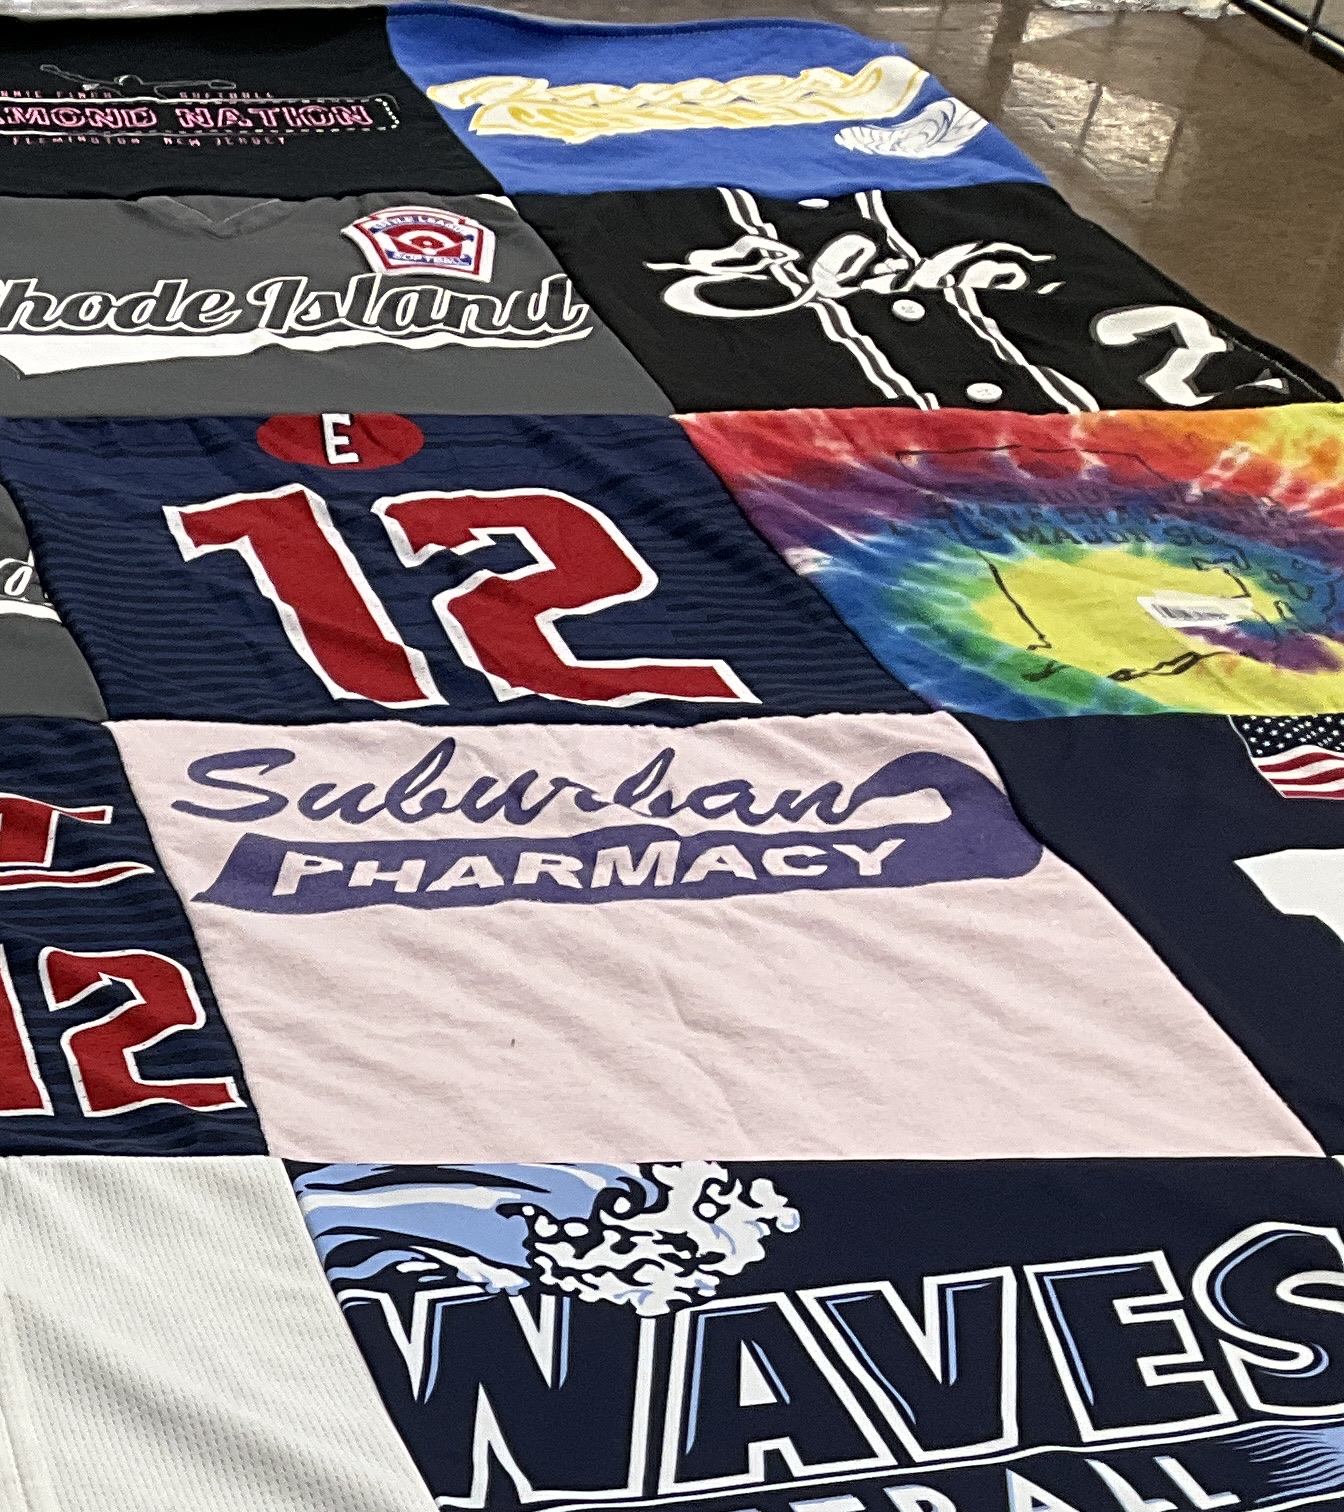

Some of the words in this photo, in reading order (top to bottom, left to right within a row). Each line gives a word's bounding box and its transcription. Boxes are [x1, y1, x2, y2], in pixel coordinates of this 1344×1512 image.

[174, 105, 376, 128] NATION
[247, 271, 593, 337] Island
[1088, 305, 1289, 407] 2
[321, 413, 360, 465] E
[162, 484, 762, 709] 12
[171, 737, 872, 825] Suburban
[272, 838, 907, 896] PHARMACY
[336, 1222, 1344, 1510] WAVES
